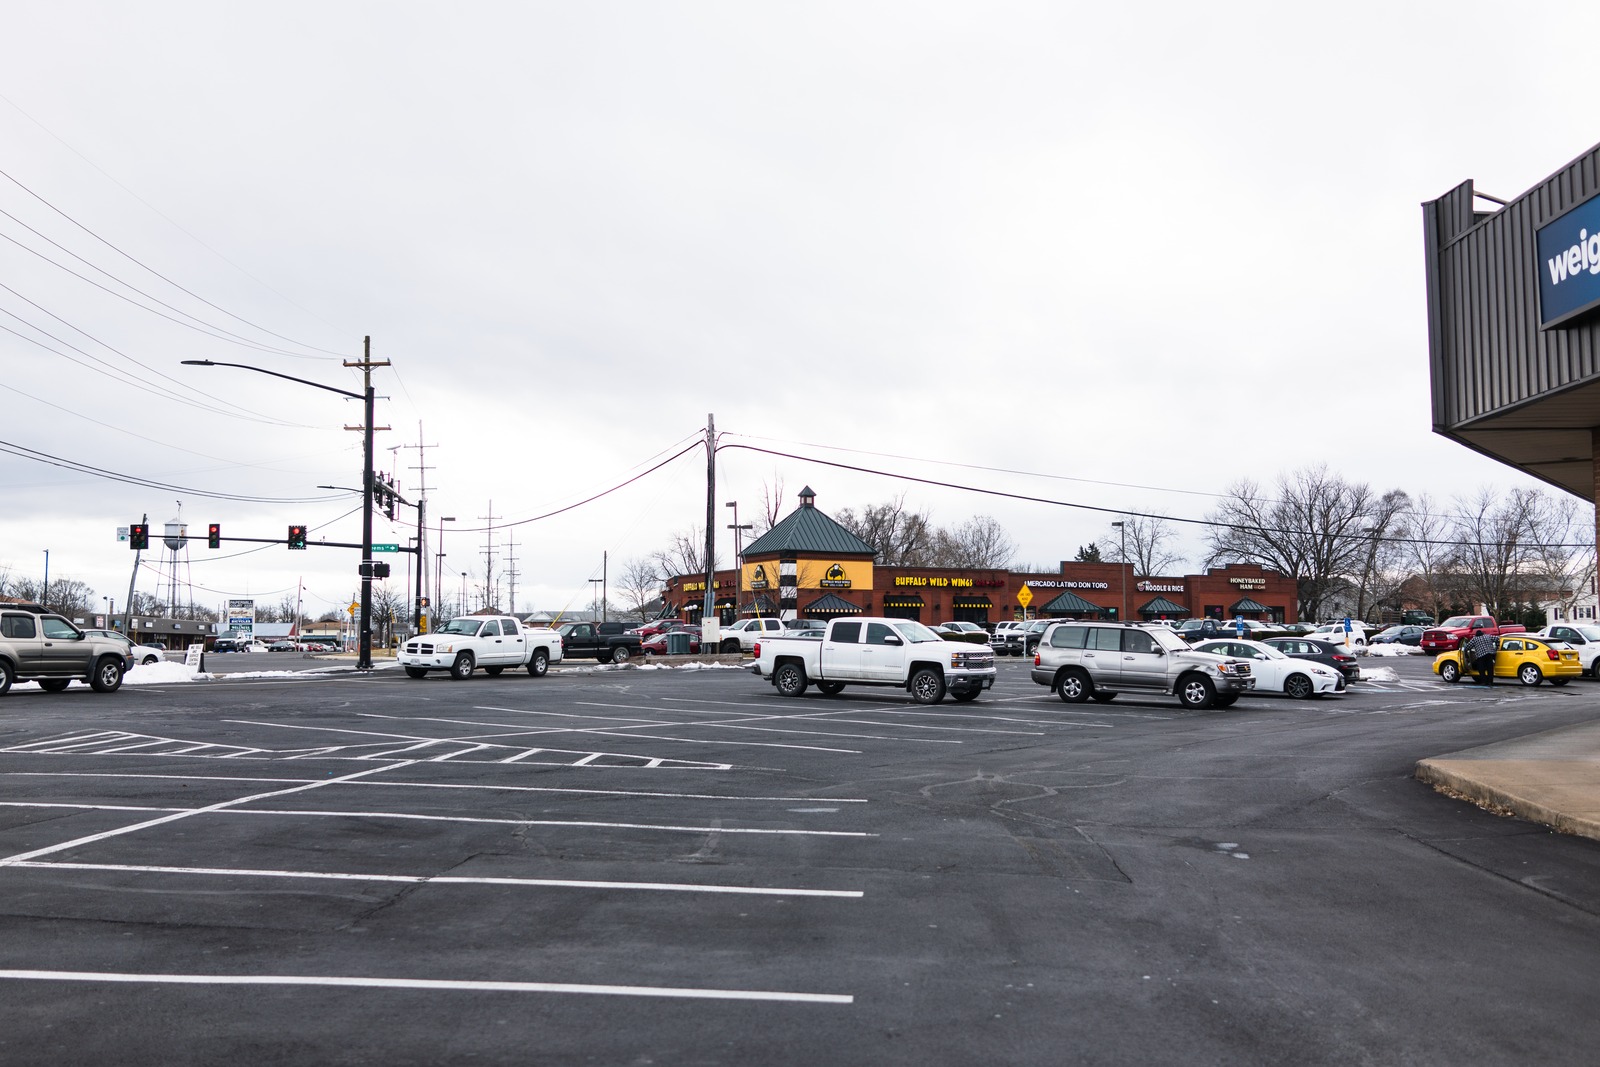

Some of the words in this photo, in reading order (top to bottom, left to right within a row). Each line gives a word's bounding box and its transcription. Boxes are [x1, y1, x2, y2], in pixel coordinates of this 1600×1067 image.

[1548, 228, 1600, 285] weig
[895, 577, 926, 586] BUFFALO
[929, 577, 948, 587] WILD
[951, 578, 973, 587] WINGS
